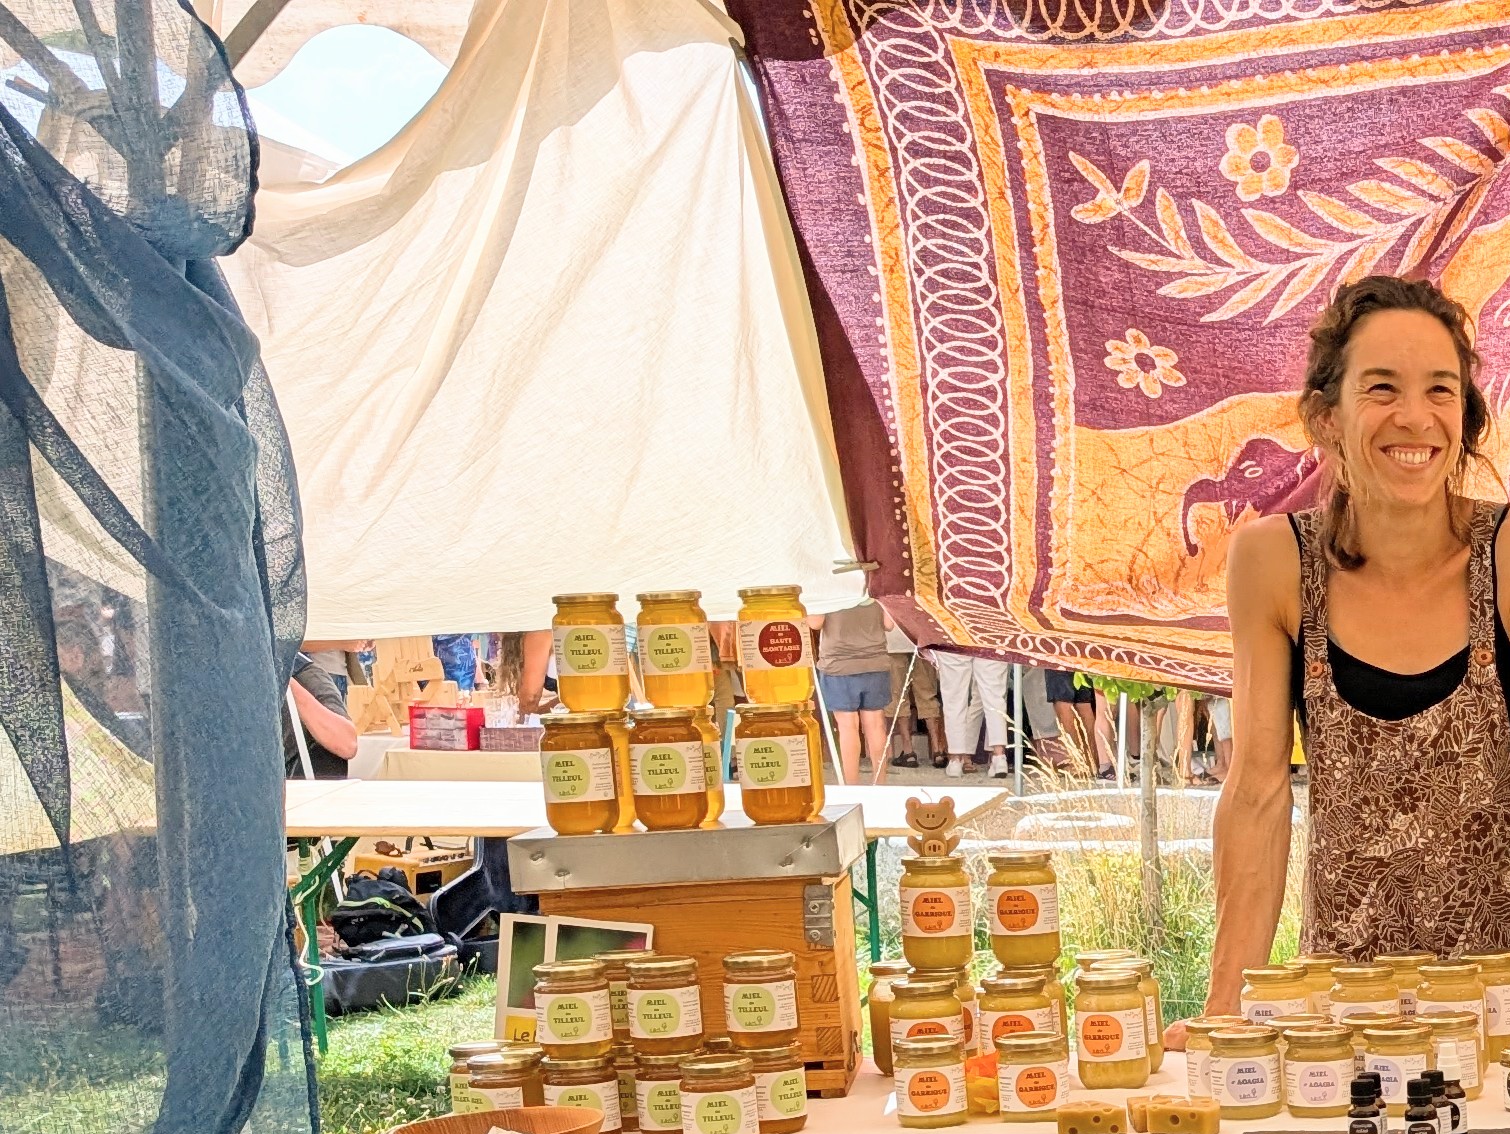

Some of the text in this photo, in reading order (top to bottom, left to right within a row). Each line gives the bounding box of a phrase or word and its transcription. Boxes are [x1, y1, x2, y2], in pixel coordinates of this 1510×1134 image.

[648, 768, 679, 776] TILLEUL
[514, 1029, 530, 1042] Le
[782, 1078, 799, 1087] MIEL
